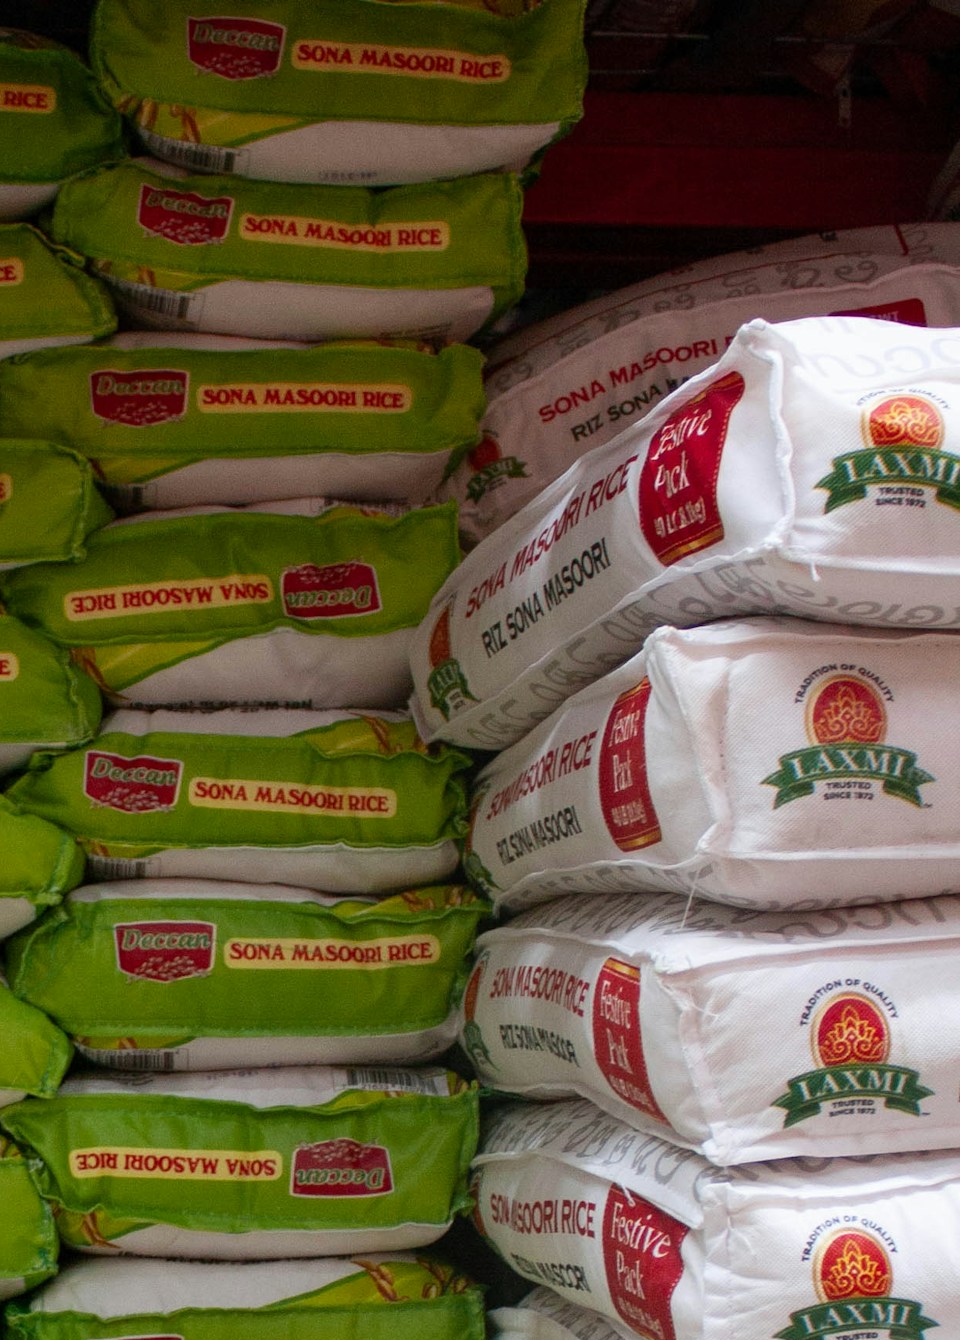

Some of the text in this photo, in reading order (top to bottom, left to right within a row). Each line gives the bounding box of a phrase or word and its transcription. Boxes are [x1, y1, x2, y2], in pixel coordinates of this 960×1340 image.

[193, 24, 279, 51] Deccan
[297, 45, 503, 78] SONA MASOORI RICE
[4, 87, 49, 108] RICE
[243, 216, 442, 247] SONA MASOORI RICE
[97, 376, 184, 395] Deccan
[539, 336, 719, 423] SONA MASOORI
[201, 387, 405, 409] SONA MASOORI RICE
[465, 561, 507, 618] SONA
[509, 491, 587, 585] MASOORI
[586, 455, 639, 520] RICE
[481, 537, 611, 659] RIZ SONA MASOORI
[795, 663, 895, 704] TRADITION OF QUALITY
[92, 758, 175, 785] Deccan
[792, 750, 906, 778] LAXMI
[194, 781, 389, 812] SONA MASOORI RICE
[826, 781, 872, 790] TRUSTED
[124, 930, 210, 951] Deccan
[229, 941, 433, 963] SONA MASOORI RICE
[798, 1070, 914, 1101] LAXMI
[77, 1153, 276, 1176] SONA MASOORI RICE
[298, 1168, 384, 1188] Deccan
[801, 1304, 911, 1332] LAXMI
